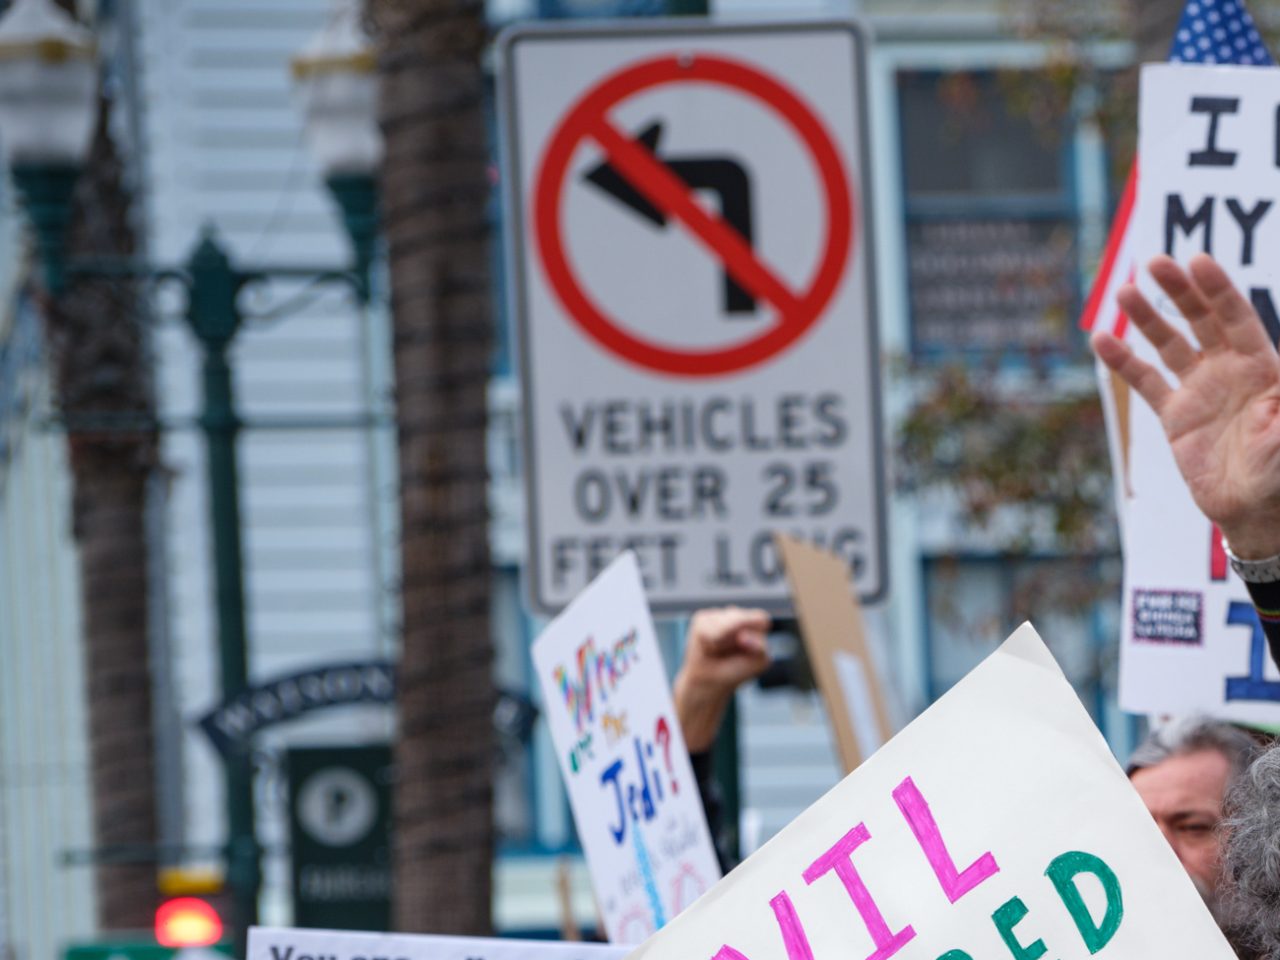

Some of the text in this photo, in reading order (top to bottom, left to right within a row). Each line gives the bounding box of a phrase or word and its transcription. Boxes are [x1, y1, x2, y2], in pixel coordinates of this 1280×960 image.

[1188, 97, 1240, 167] I
[1164, 193, 1275, 268] MY
[559, 392, 848, 454] VEHICLES
[574, 460, 839, 523] OVER 25
[708, 526, 866, 586] LOG
